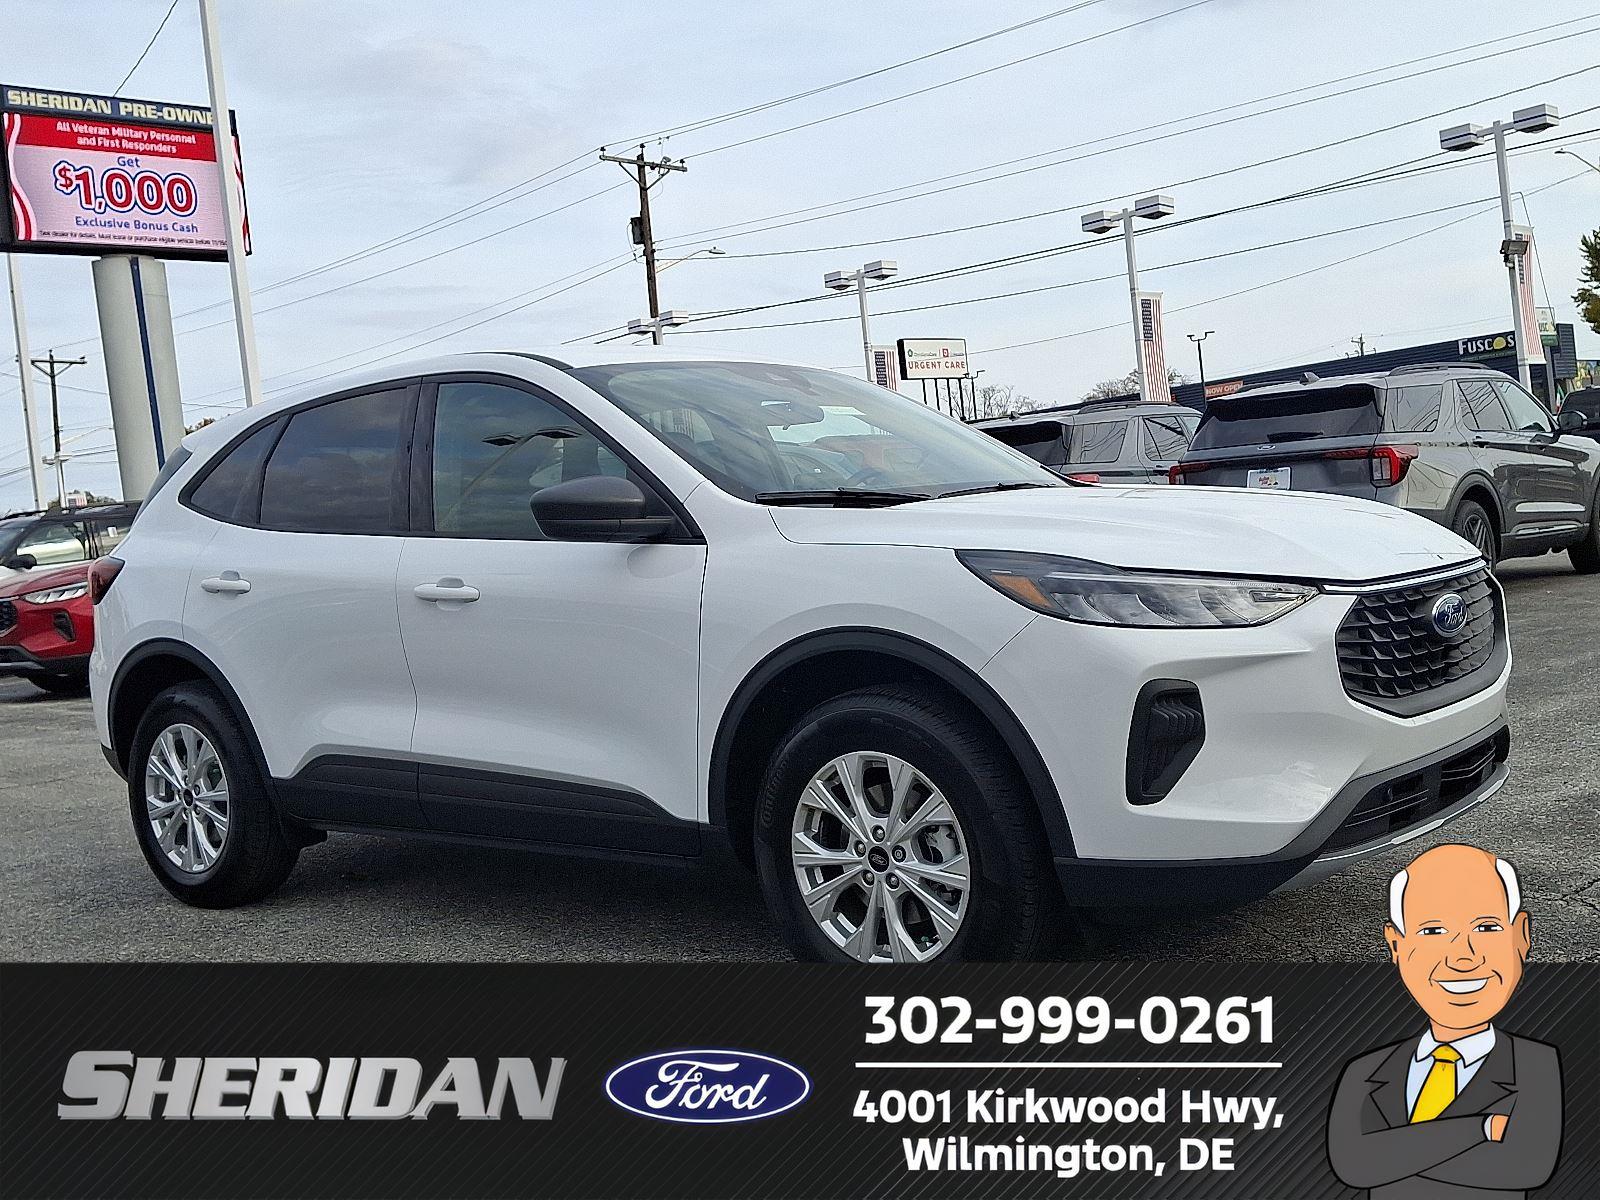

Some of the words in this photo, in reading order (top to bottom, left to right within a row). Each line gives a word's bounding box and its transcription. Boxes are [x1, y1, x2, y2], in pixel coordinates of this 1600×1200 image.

[7, 90, 112, 115] SHERIDAN
[118, 101, 213, 125] PRE-OWNE
[56, 121, 71, 132] All
[72, 123, 110, 135] Veteran
[111, 126, 148, 140] Military
[149, 130, 196, 144] Personnel
[77, 136, 96, 146] and
[98, 137, 120, 148] First
[121, 139, 177, 153] Responders
[117, 156, 140, 167] Get
[54, 162, 196, 216] $1,000
[75, 216, 131, 230] Exclusive
[134, 219, 169, 232] Bonus
[171, 221, 198, 233] Cash
[908, 361, 941, 369] URGENT
[944, 361, 966, 369] CARE
[1205, 386, 1223, 395] NOW
